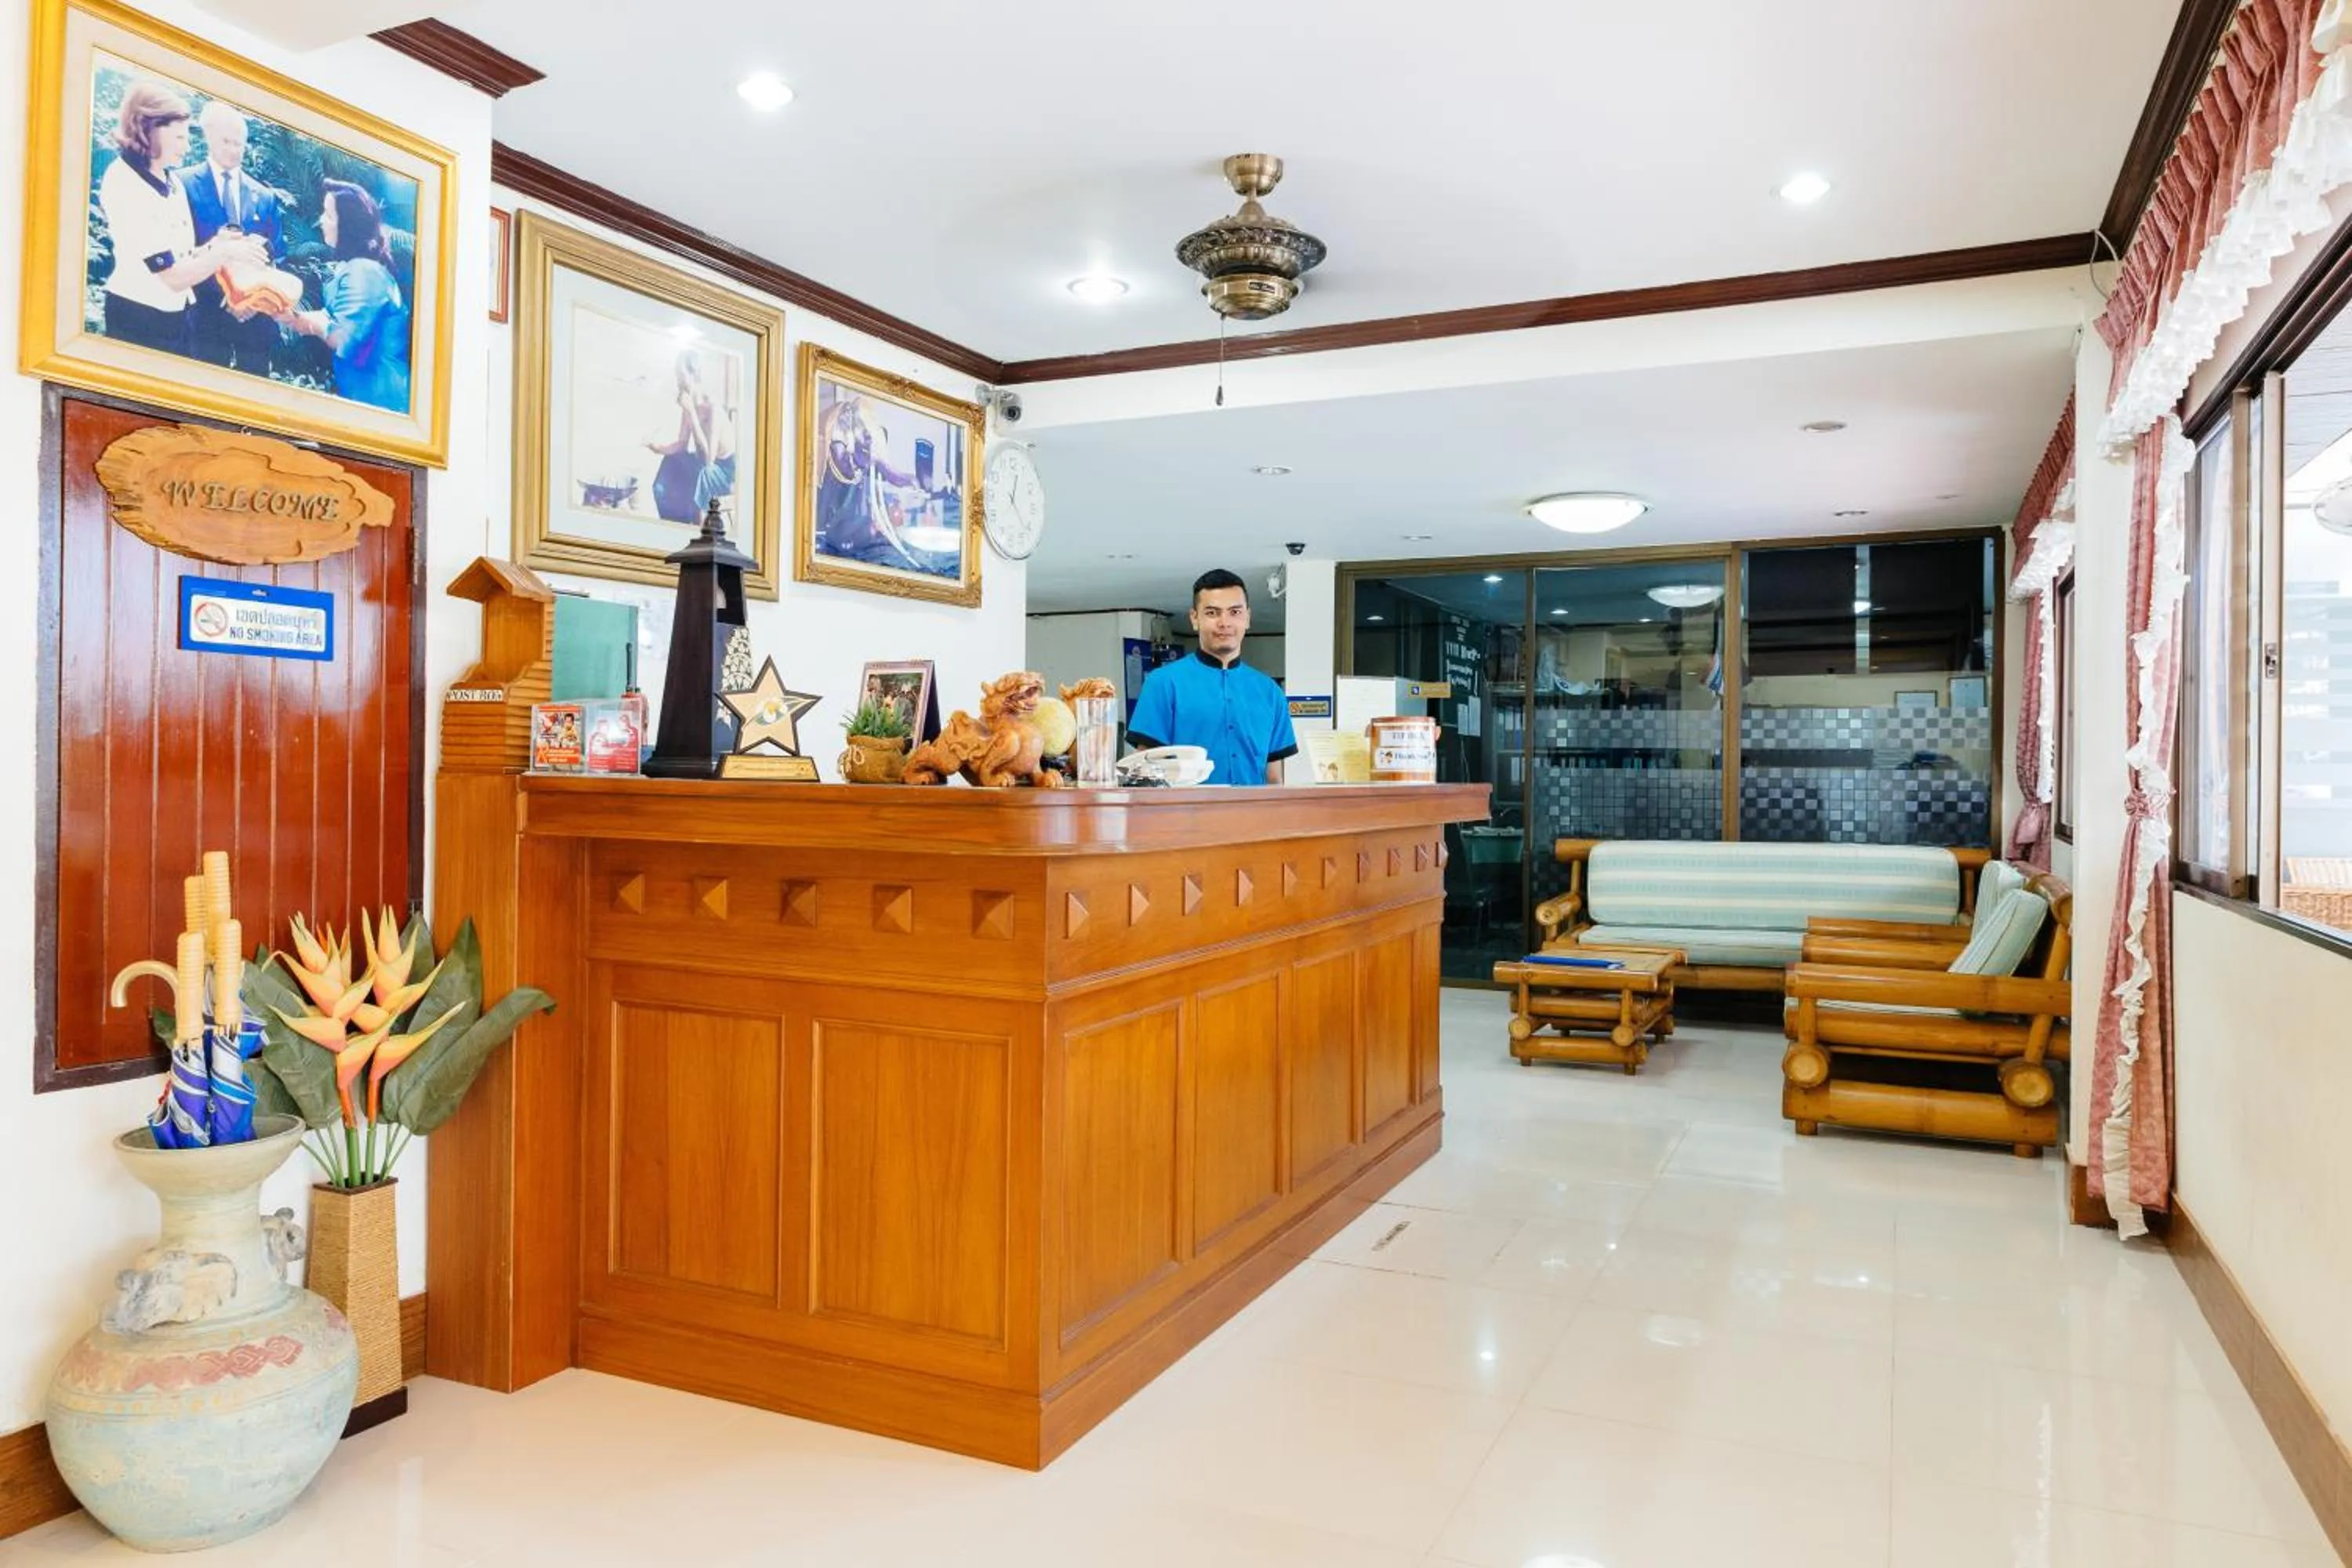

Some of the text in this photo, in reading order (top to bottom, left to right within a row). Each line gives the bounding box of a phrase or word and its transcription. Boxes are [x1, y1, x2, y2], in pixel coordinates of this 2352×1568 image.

[161, 479, 339, 522] WELCOME
[229, 626, 322, 647] NO SMOKING AREA
